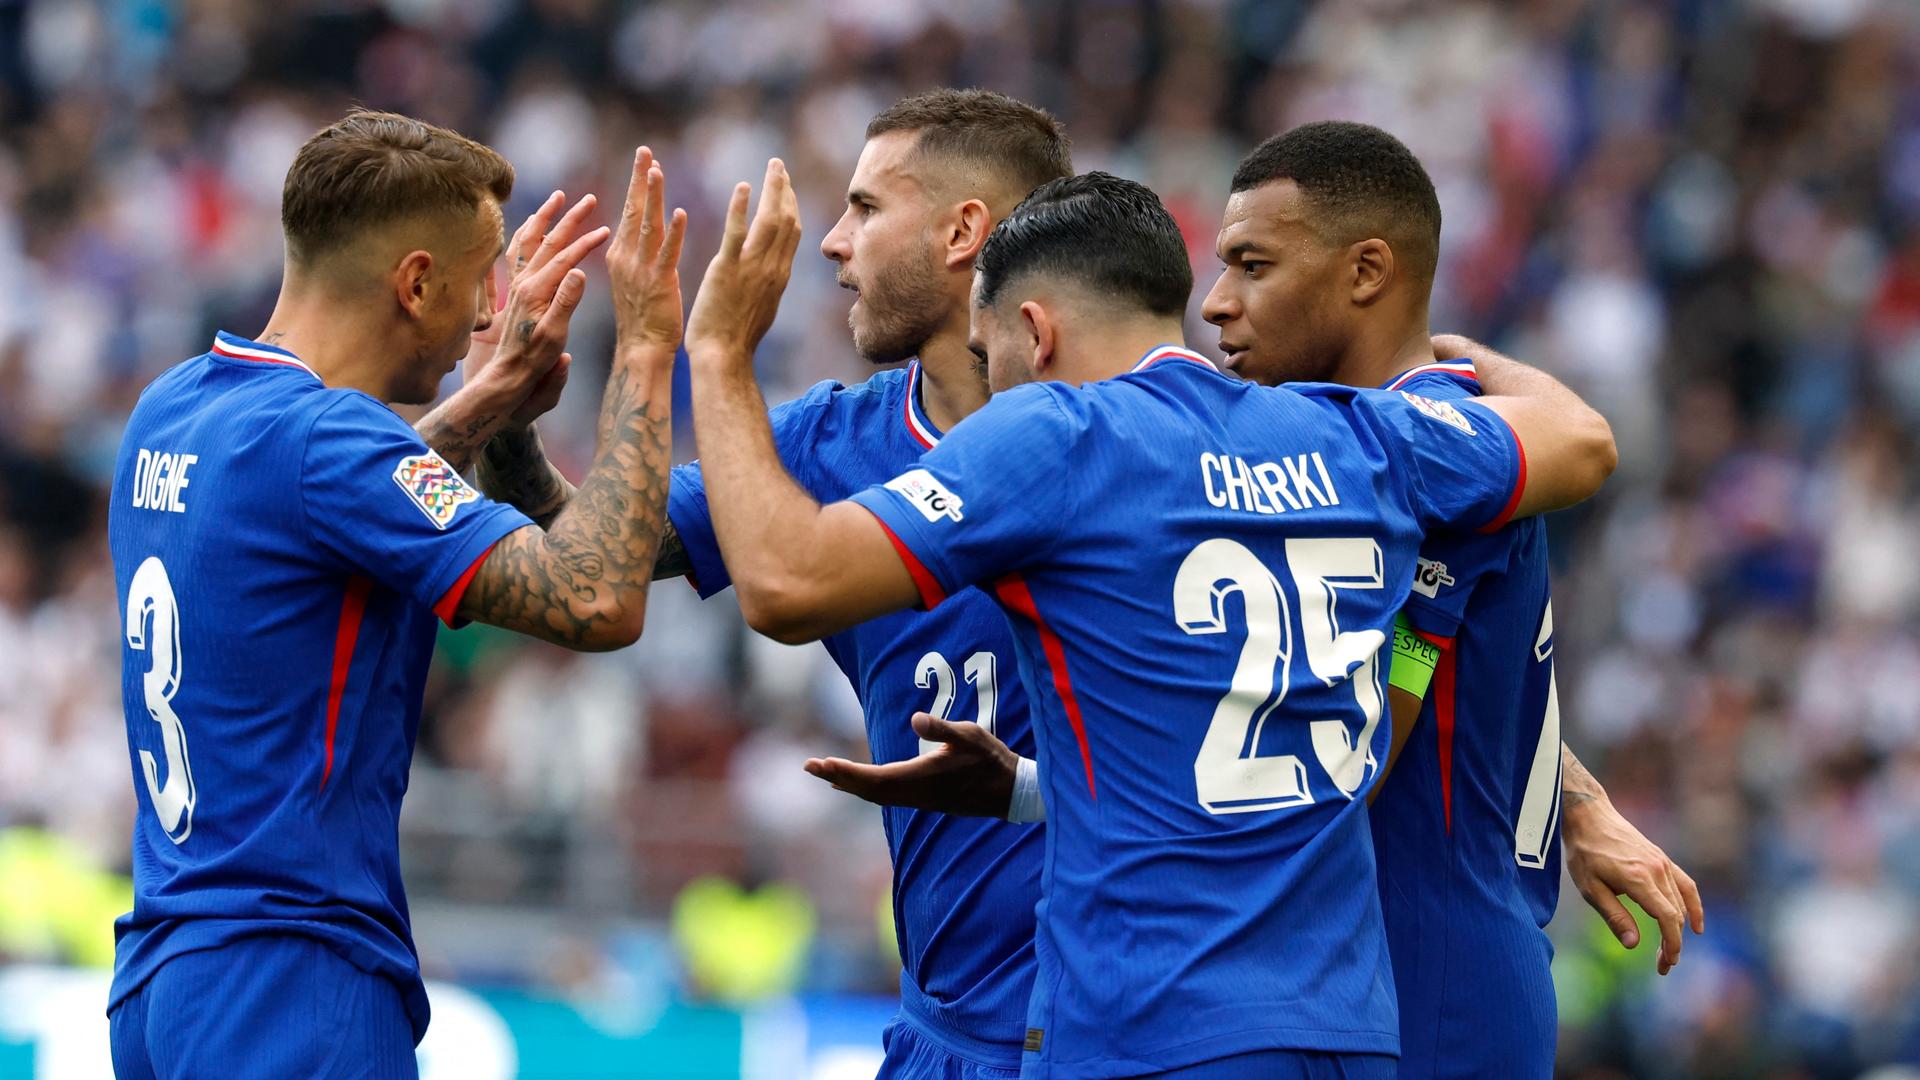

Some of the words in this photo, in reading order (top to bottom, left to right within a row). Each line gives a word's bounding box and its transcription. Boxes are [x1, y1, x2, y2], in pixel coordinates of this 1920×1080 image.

[133, 448, 199, 513] DIGNE
[1200, 452, 1340, 514] CHERKI
[1173, 538, 1386, 815] 25
[1393, 630, 1440, 661] ESPEC
[127, 556, 196, 844] 3
[915, 651, 998, 757] 21
